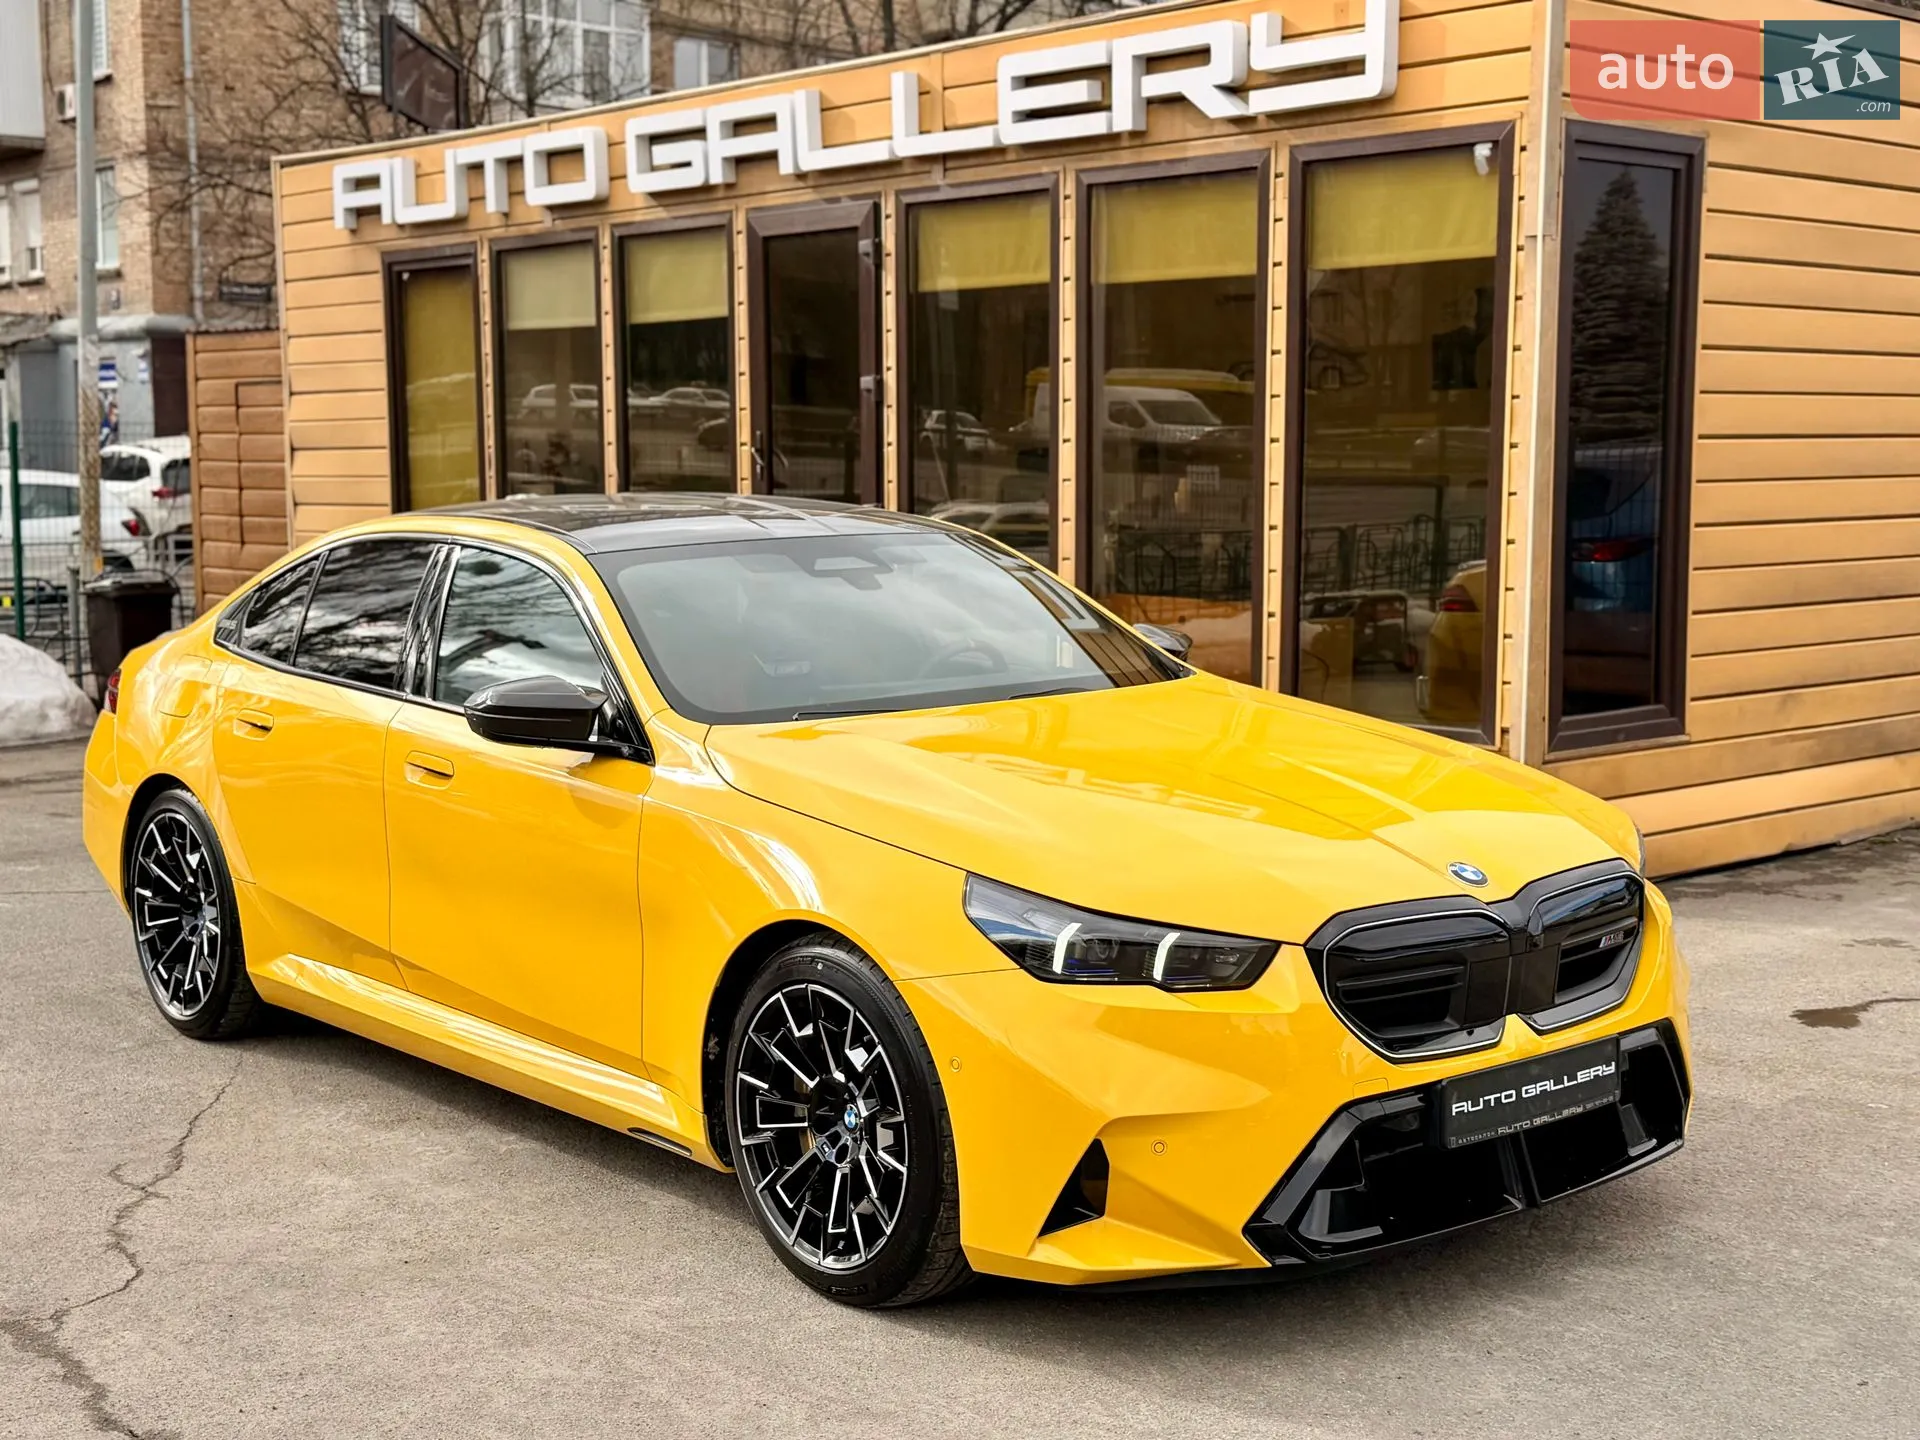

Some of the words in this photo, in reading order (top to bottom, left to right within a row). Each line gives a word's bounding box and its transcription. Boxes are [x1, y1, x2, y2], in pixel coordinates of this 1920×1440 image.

[333, 126, 609, 230] AUTO
[626, 0, 1400, 193] GALLERY
[1451, 1089, 1516, 1116] AUTO
[1521, 1061, 1616, 1098] GALLERY
[1498, 1120, 1531, 1135] AUTO
